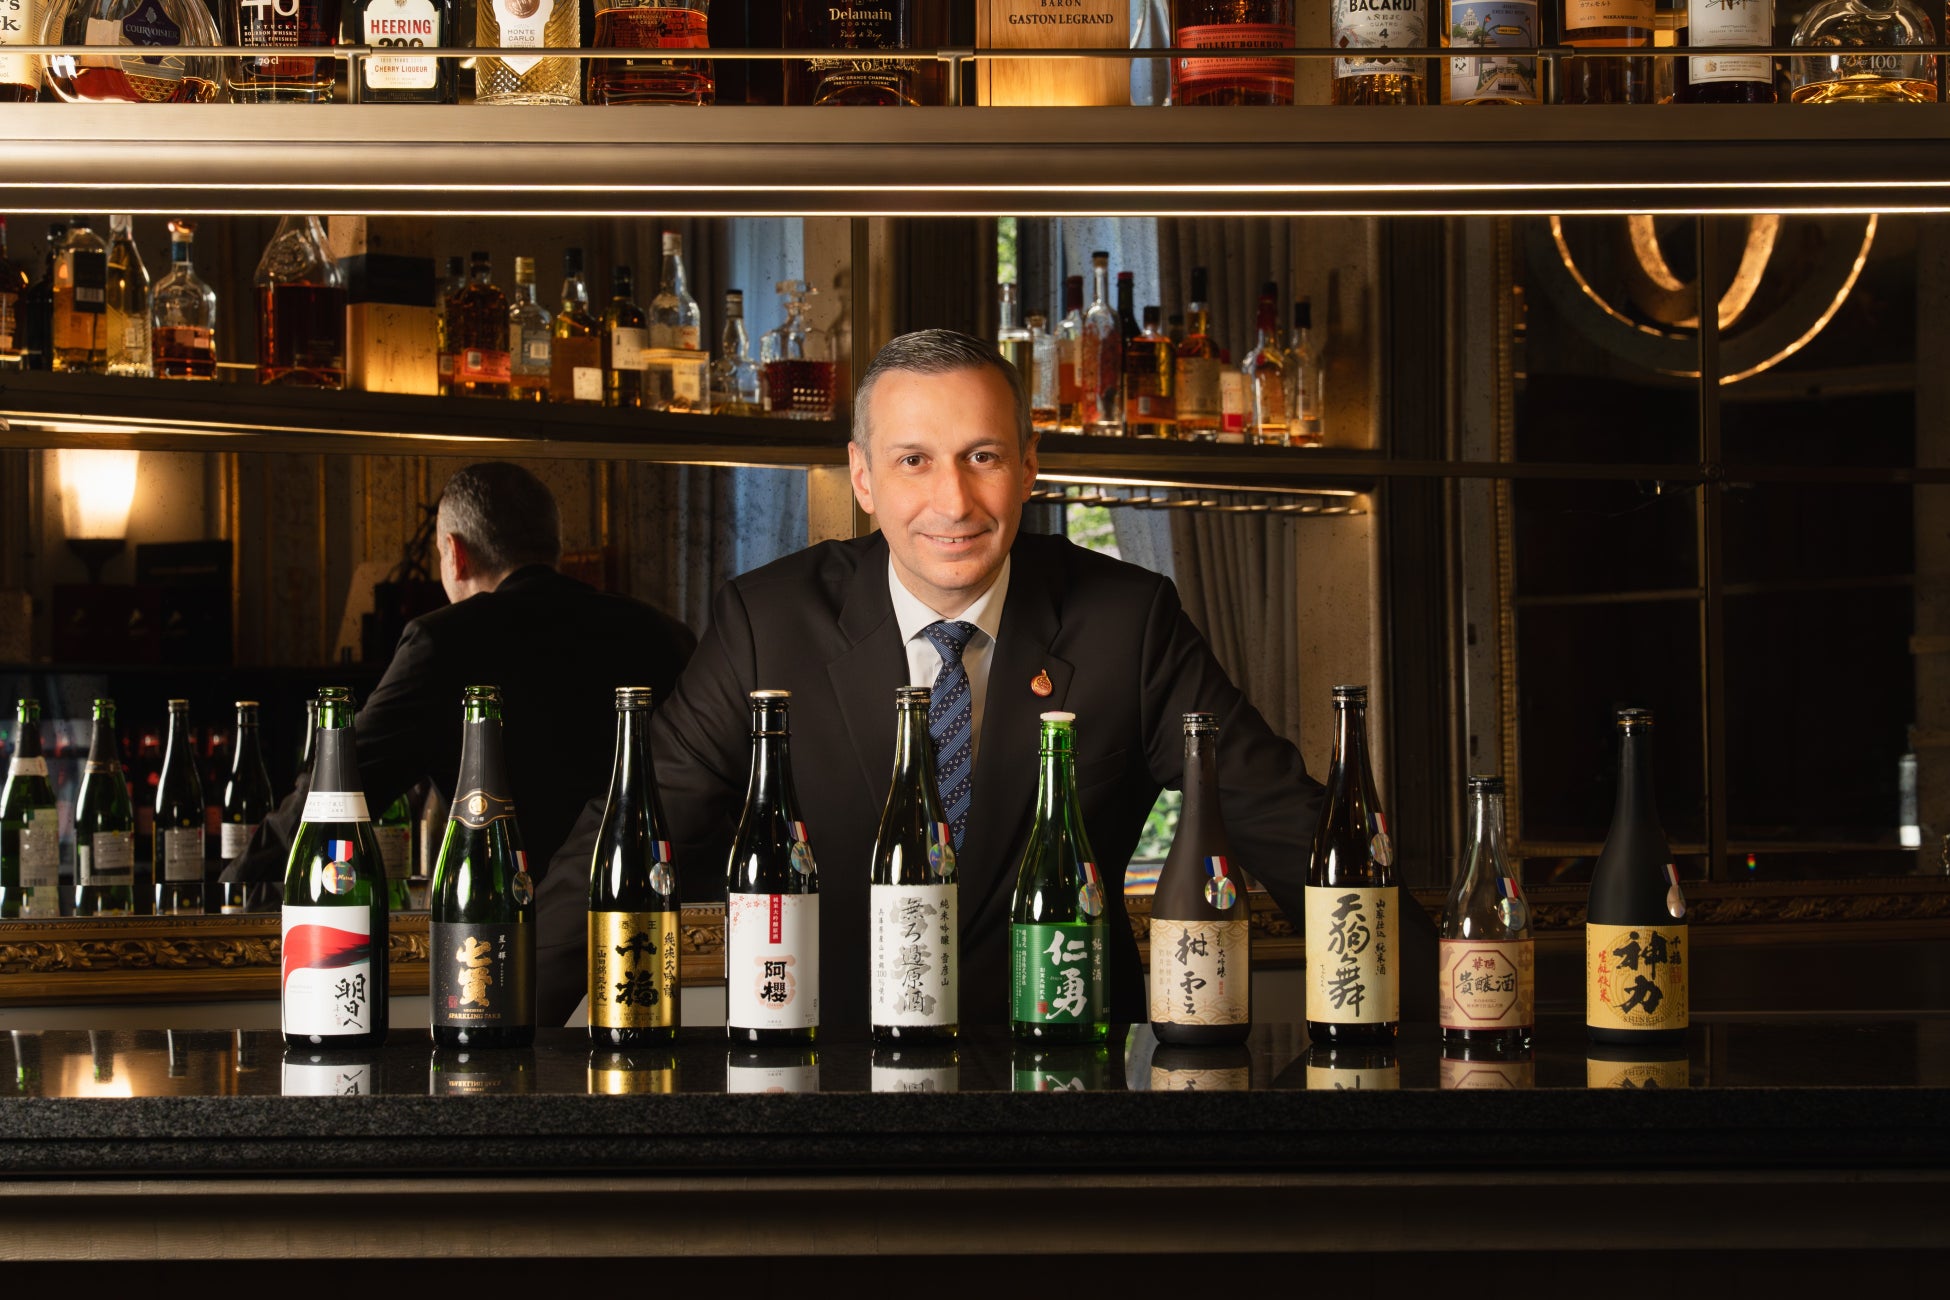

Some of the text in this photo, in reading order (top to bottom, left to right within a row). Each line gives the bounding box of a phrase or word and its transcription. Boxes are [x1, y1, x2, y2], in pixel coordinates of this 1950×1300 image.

[1349, 0, 1417, 12] BACARDI
[829, 7, 893, 21] Delamain
[1009, 14, 1114, 24] GASTON LEGRAND
[125, 24, 178, 40] COURVOISIER
[371, 19, 432, 34] HEERING
[1379, 28, 1390, 39] 4
[375, 65, 400, 73] CHERRY
[851, 61, 872, 72] XO
[1042, 930, 1088, 1020] 仁勇
[1613, 931, 1668, 1015] 神力
[1455, 970, 1515, 995] 貴醸酒
